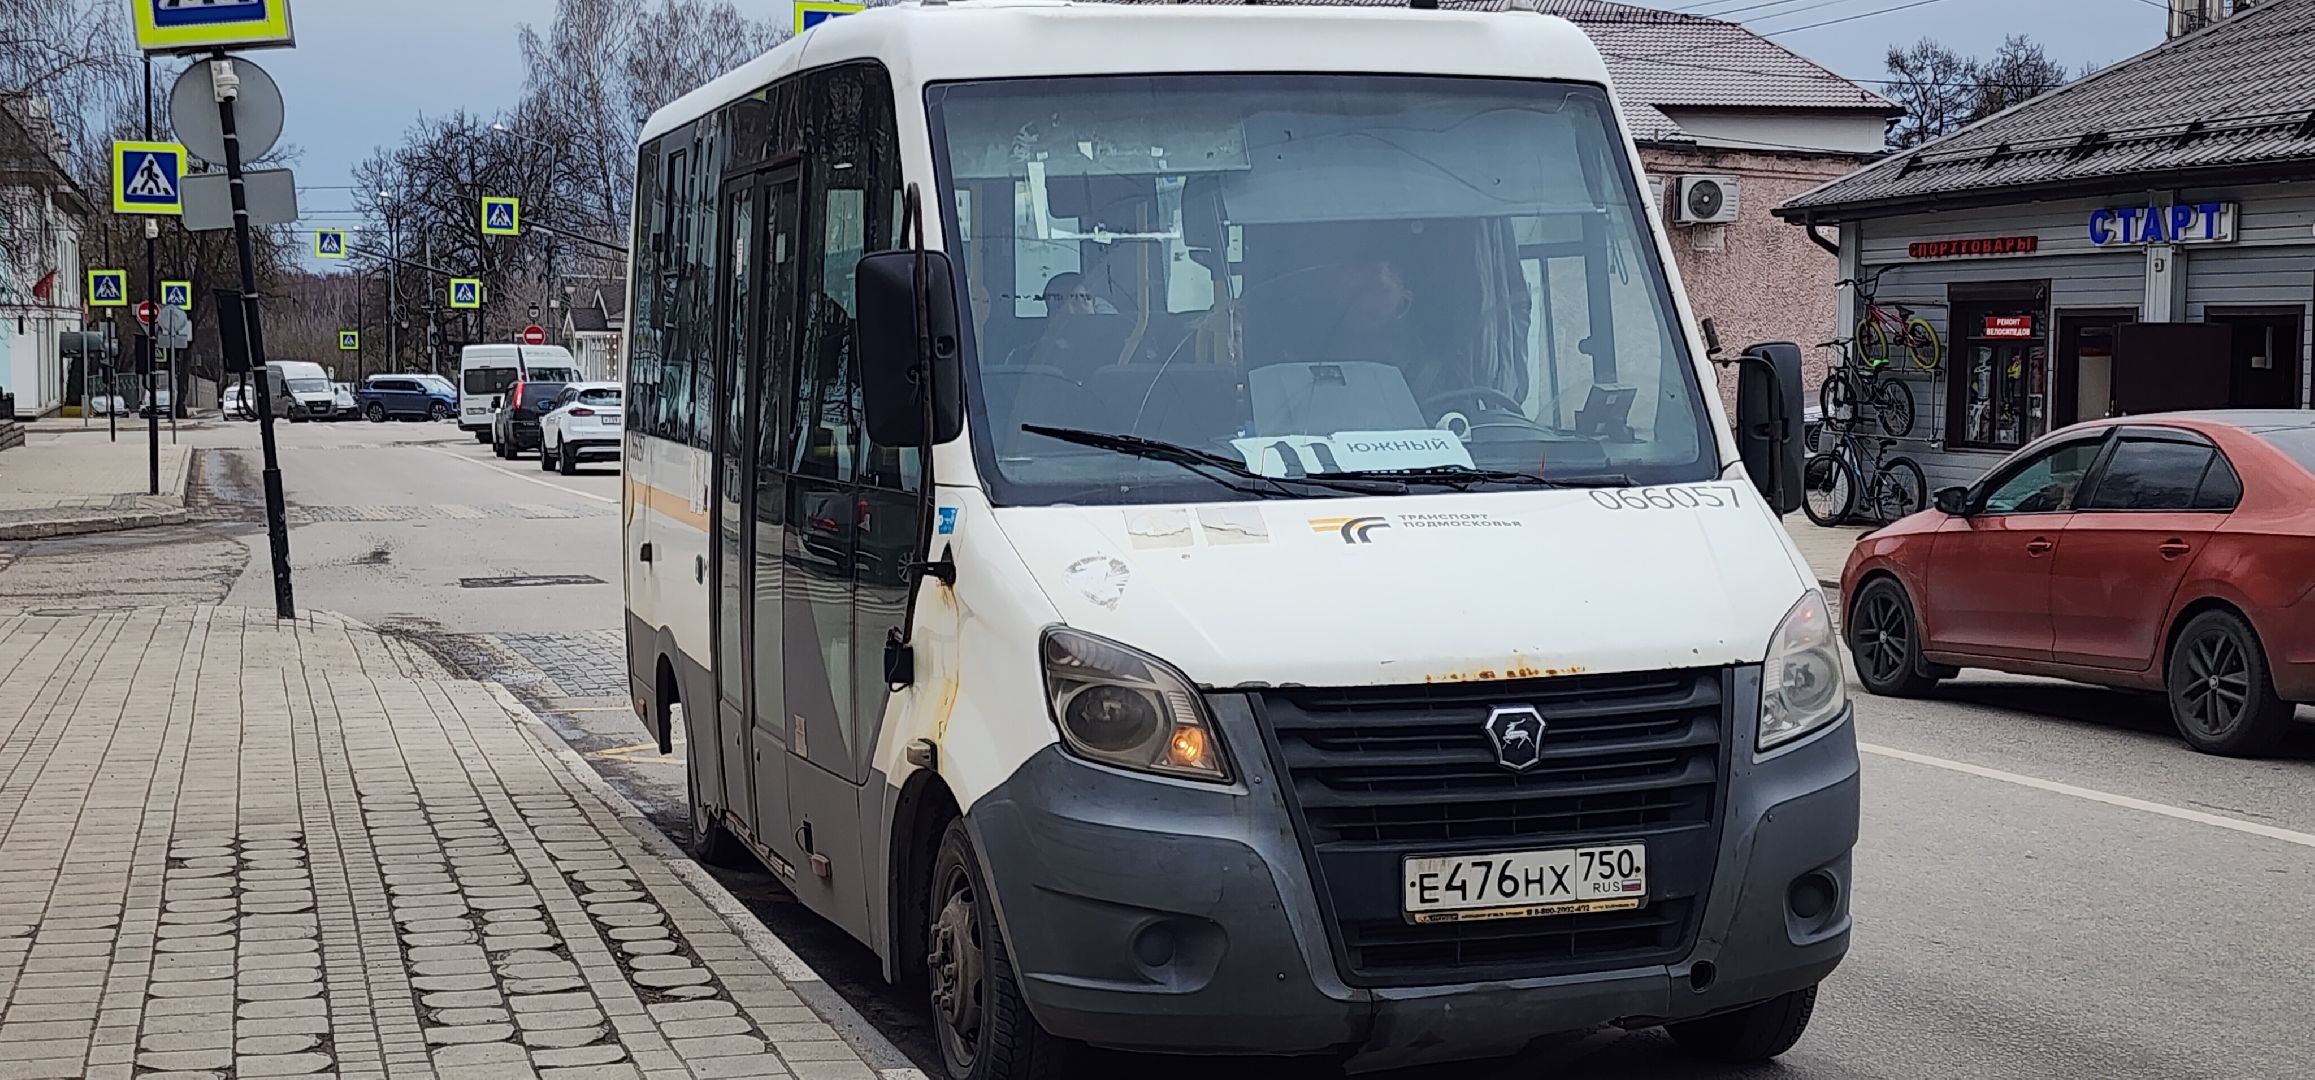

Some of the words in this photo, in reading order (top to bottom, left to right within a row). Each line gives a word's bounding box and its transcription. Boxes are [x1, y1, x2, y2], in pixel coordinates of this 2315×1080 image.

[2089, 202, 2226, 245] СТАРТ
[1910, 237, 2034, 257] СПОРТТОВАРЫ
[1996, 318, 2021, 326] РЕМОНТ
[1986, 327, 2031, 337] ВЕЛОСИПЕДОВ
[1346, 437, 1450, 453] ЮЖНЫЙ
[1588, 486, 1740, 510] 066057
[1397, 513, 1488, 521] ТРАНСПОРТ
[1578, 848, 1634, 882] 750
[1592, 881, 1621, 894] RUS
